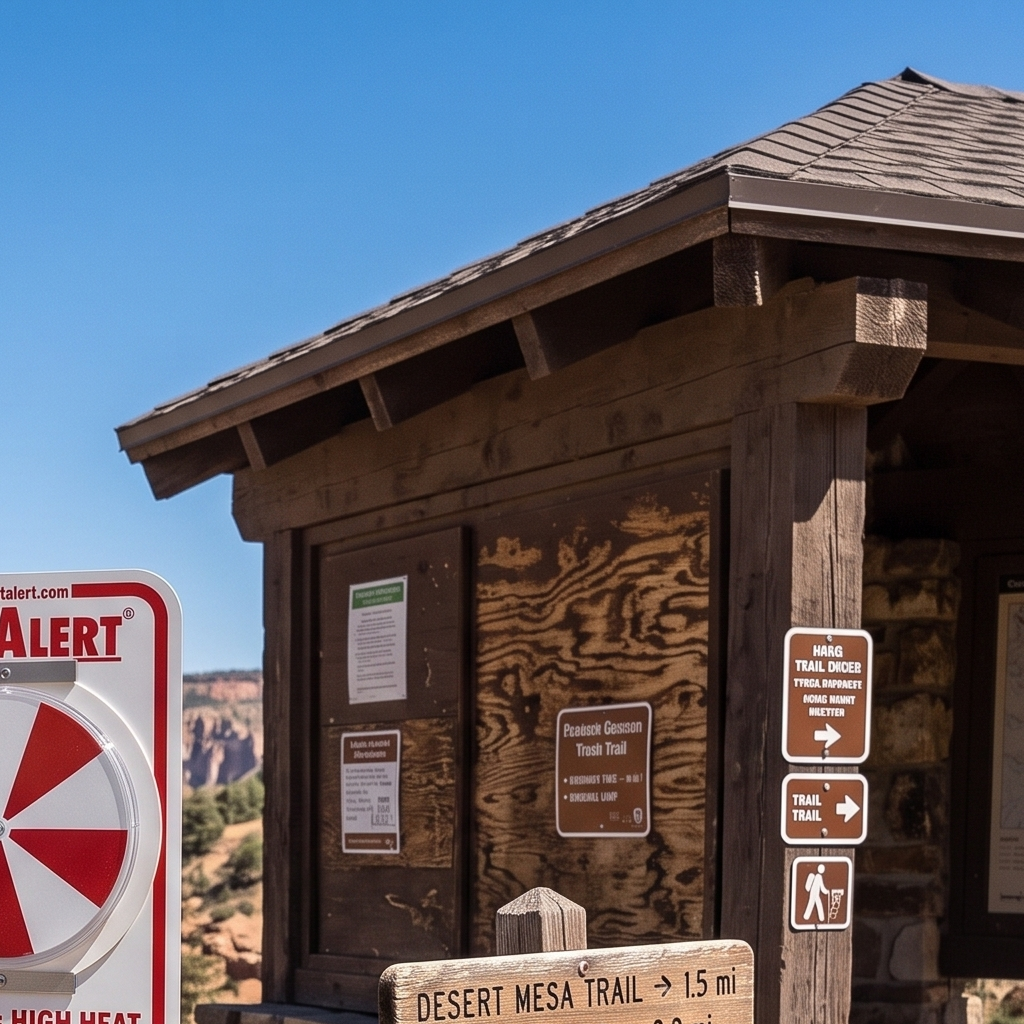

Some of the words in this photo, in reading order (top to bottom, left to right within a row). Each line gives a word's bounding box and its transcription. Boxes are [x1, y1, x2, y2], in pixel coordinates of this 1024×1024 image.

[794, 659, 826, 673] TRAIL
[605, 740, 627, 755] Trail
[792, 794, 822, 806] TRAIL
[792, 809, 822, 821] TRAIL
[417, 985, 504, 1022] DESERT
[515, 980, 574, 1014] MESA
[584, 974, 644, 1008] TRAIL
[684, 969, 708, 999] 1.5
[716, 966, 736, 996] mi
